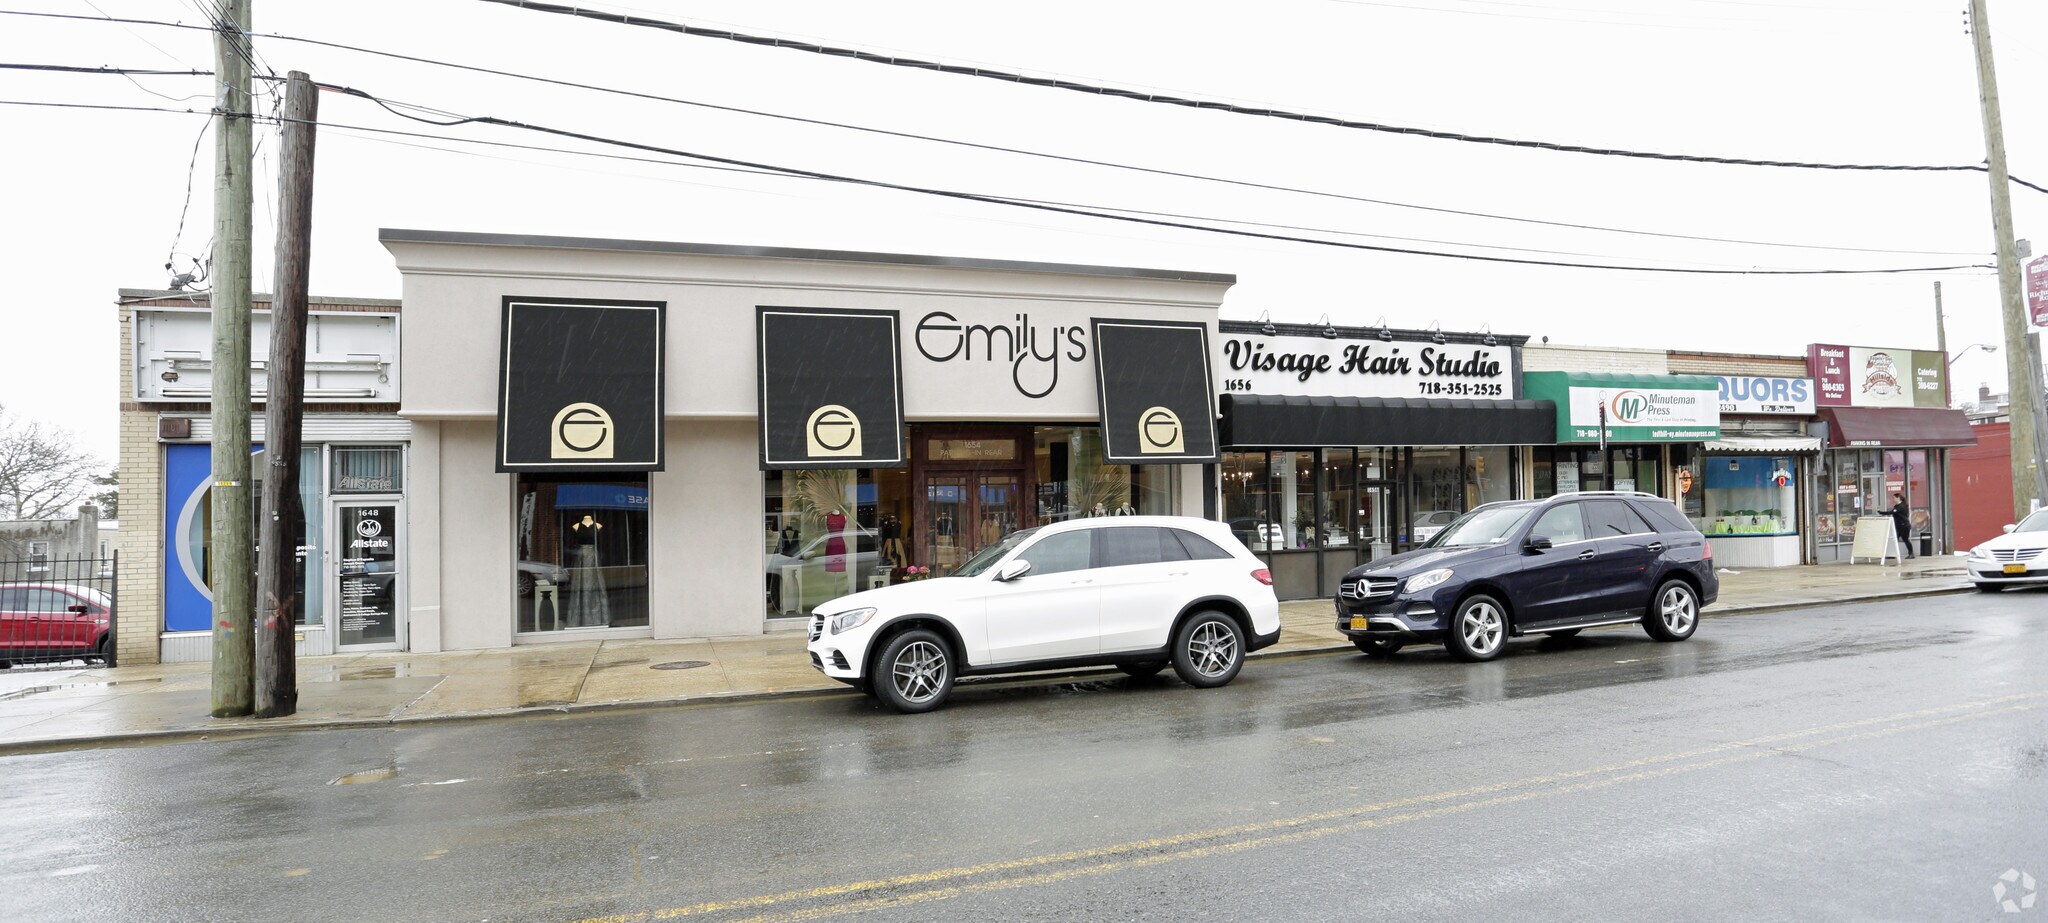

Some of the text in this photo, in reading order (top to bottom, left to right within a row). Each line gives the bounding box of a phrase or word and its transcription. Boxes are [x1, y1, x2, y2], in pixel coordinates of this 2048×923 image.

[915, 311, 1087, 399] Emily's
[1820, 348, 1844, 358] Breakfast
[1224, 340, 1503, 382] Visage Hair Studio
[1830, 358, 1835, 366] &
[1824, 366, 1841, 375] Lunch
[1917, 368, 1938, 378] Catering
[1224, 379, 1252, 391] 1656
[1418, 382, 1502, 396] 718-351-2525
[1649, 393, 1696, 405] Minuteman
[1647, 404, 1671, 415] Press
[339, 476, 392, 490] Allstate
[357, 509, 379, 517] 1648
[350, 539, 389, 548] Allstate
